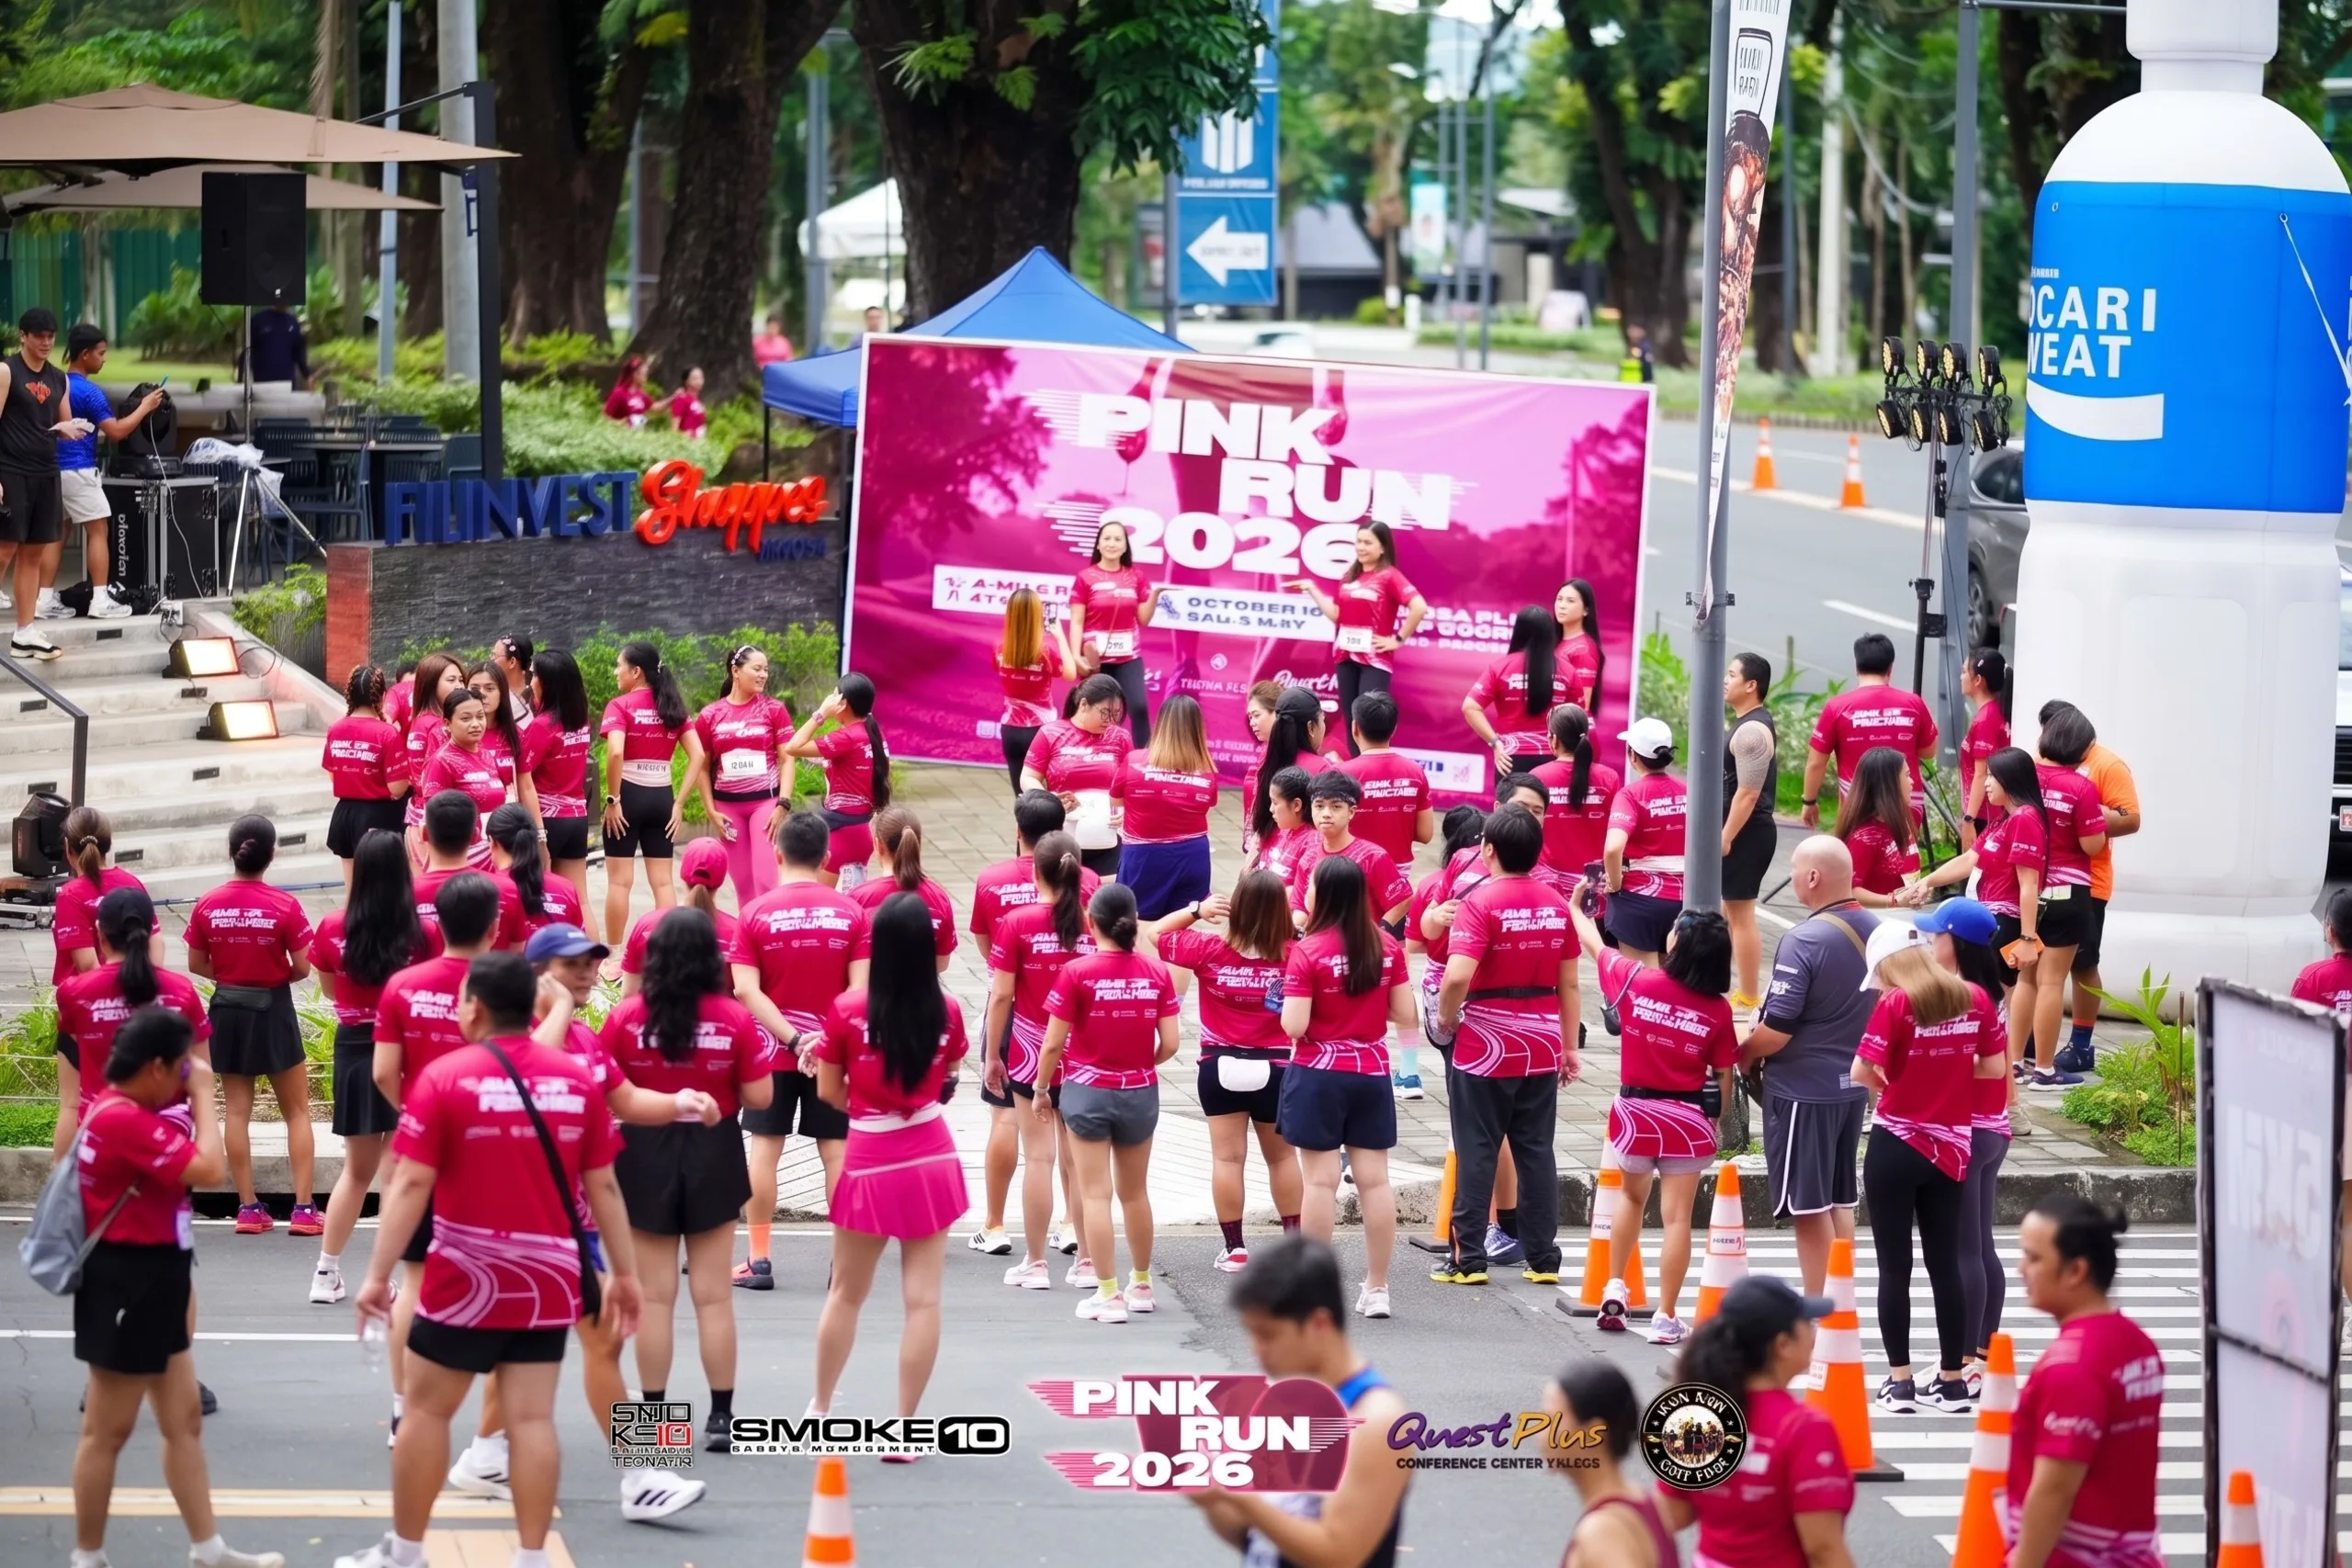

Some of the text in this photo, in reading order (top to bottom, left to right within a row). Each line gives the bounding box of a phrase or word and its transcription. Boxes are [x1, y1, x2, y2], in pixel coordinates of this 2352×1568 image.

[1079, 392, 1340, 466] PINK
[384, 459, 831, 553] FILINVEST Shoppes
[1219, 457, 1452, 530] RUN
[1100, 506, 1361, 581] 2026
[1188, 597, 1296, 615] OCTOBER
